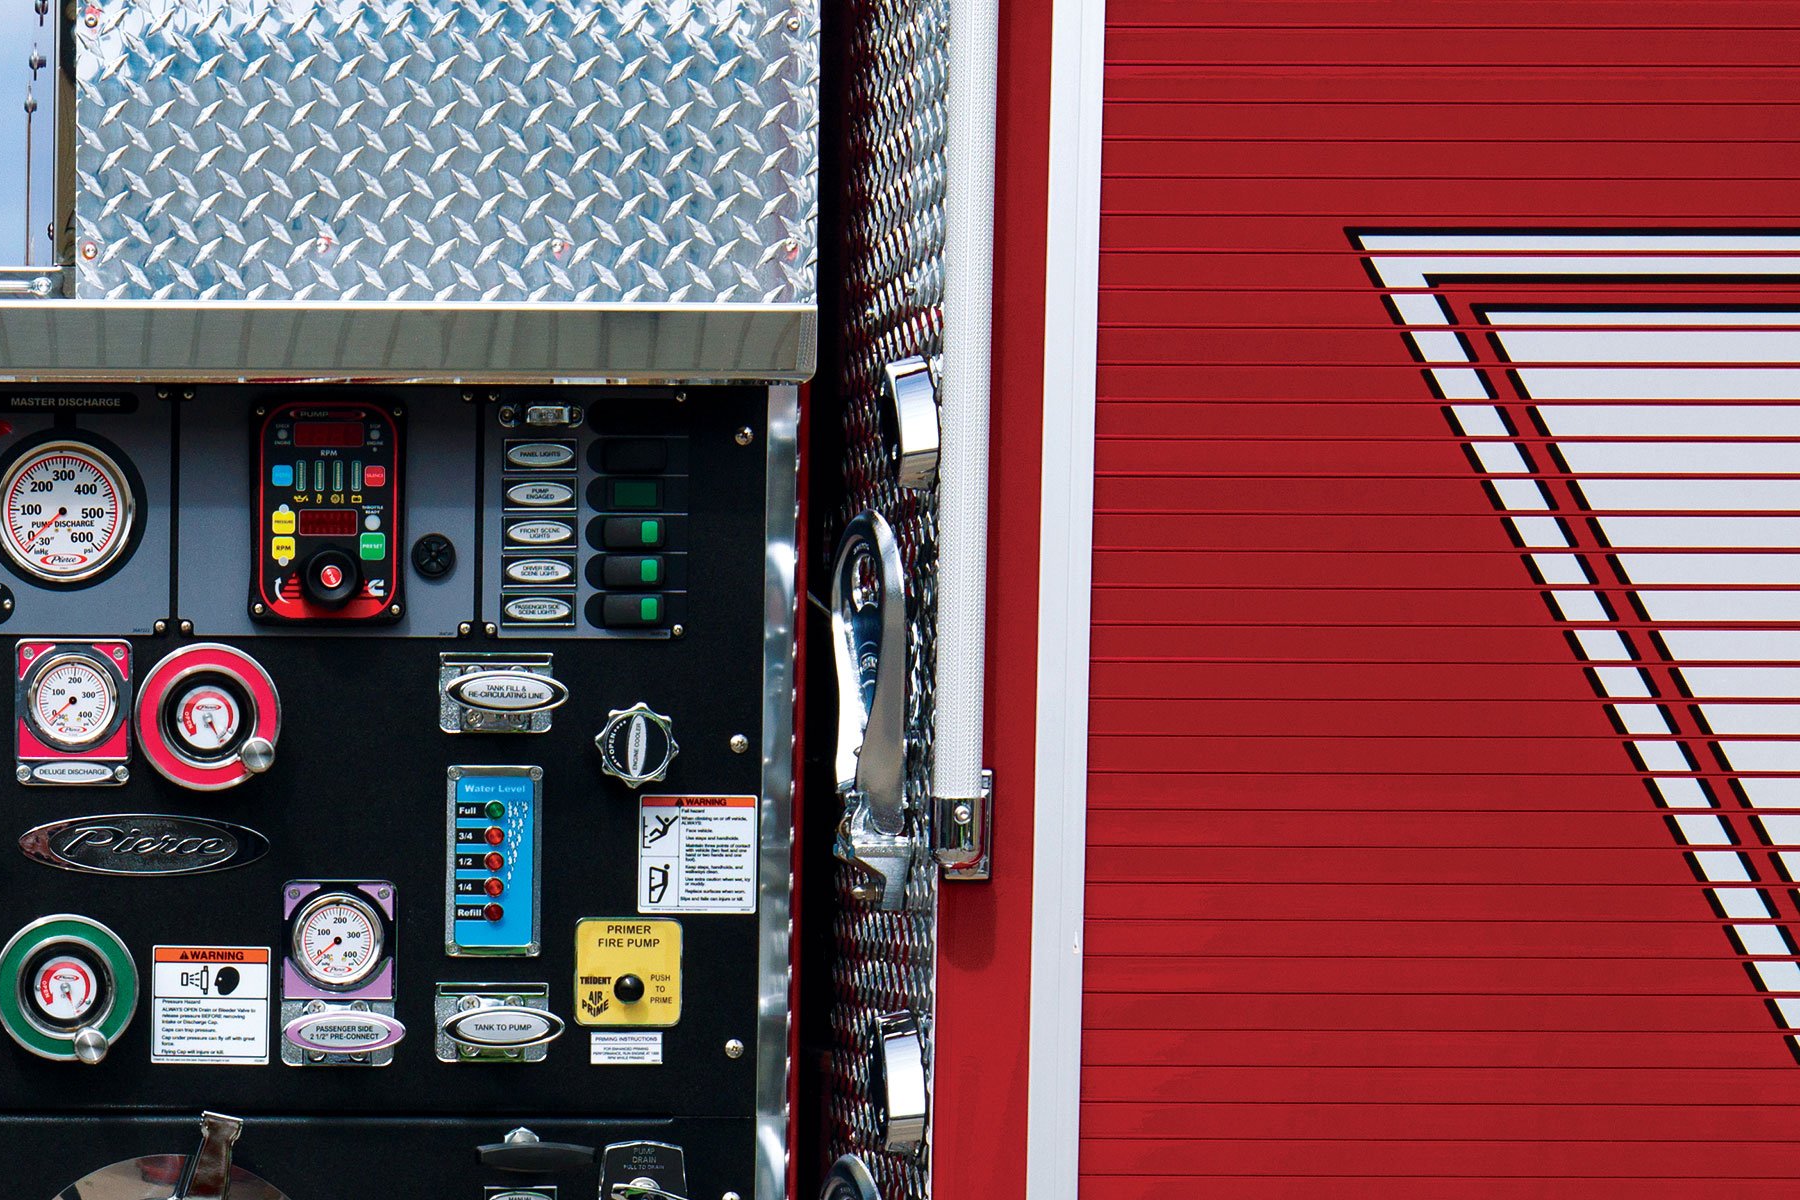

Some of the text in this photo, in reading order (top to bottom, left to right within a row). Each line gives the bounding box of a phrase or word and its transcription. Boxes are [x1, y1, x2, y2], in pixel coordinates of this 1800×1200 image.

[10, 398, 121, 407] MASTER DISCHARGE
[52, 470, 75, 481] 300
[30, 481, 53, 493] 200
[74, 484, 98, 495] 400
[20, 504, 42, 515] 100
[81, 508, 104, 519] 500
[55, 520, 95, 528] DISCHARGE
[70, 532, 94, 543] 600
[633, 723, 641, 749] COOLER
[465, 784, 526, 793] Water Level
[685, 798, 727, 806] WARNING
[459, 806, 476, 815] Full
[459, 832, 473, 840] 3/4
[63, 826, 226, 857] Pierce
[458, 858, 472, 866] 1/2
[458, 883, 472, 892] 1/4
[458, 908, 482, 917] Refill
[607, 925, 651, 935] PRIMER
[598, 938, 660, 948] FIRE PUMP
[190, 951, 244, 960] WARNING
[580, 976, 612, 985] TRIDENT
[650, 974, 671, 982] PUSH
[589, 991, 603, 1002] AIR
[650, 996, 673, 1004] PRIME
[581, 1001, 609, 1017] PRIME
[315, 1025, 373, 1033] PASSENGER SIDE
[474, 1023, 532, 1031] TANK TO PUMP
